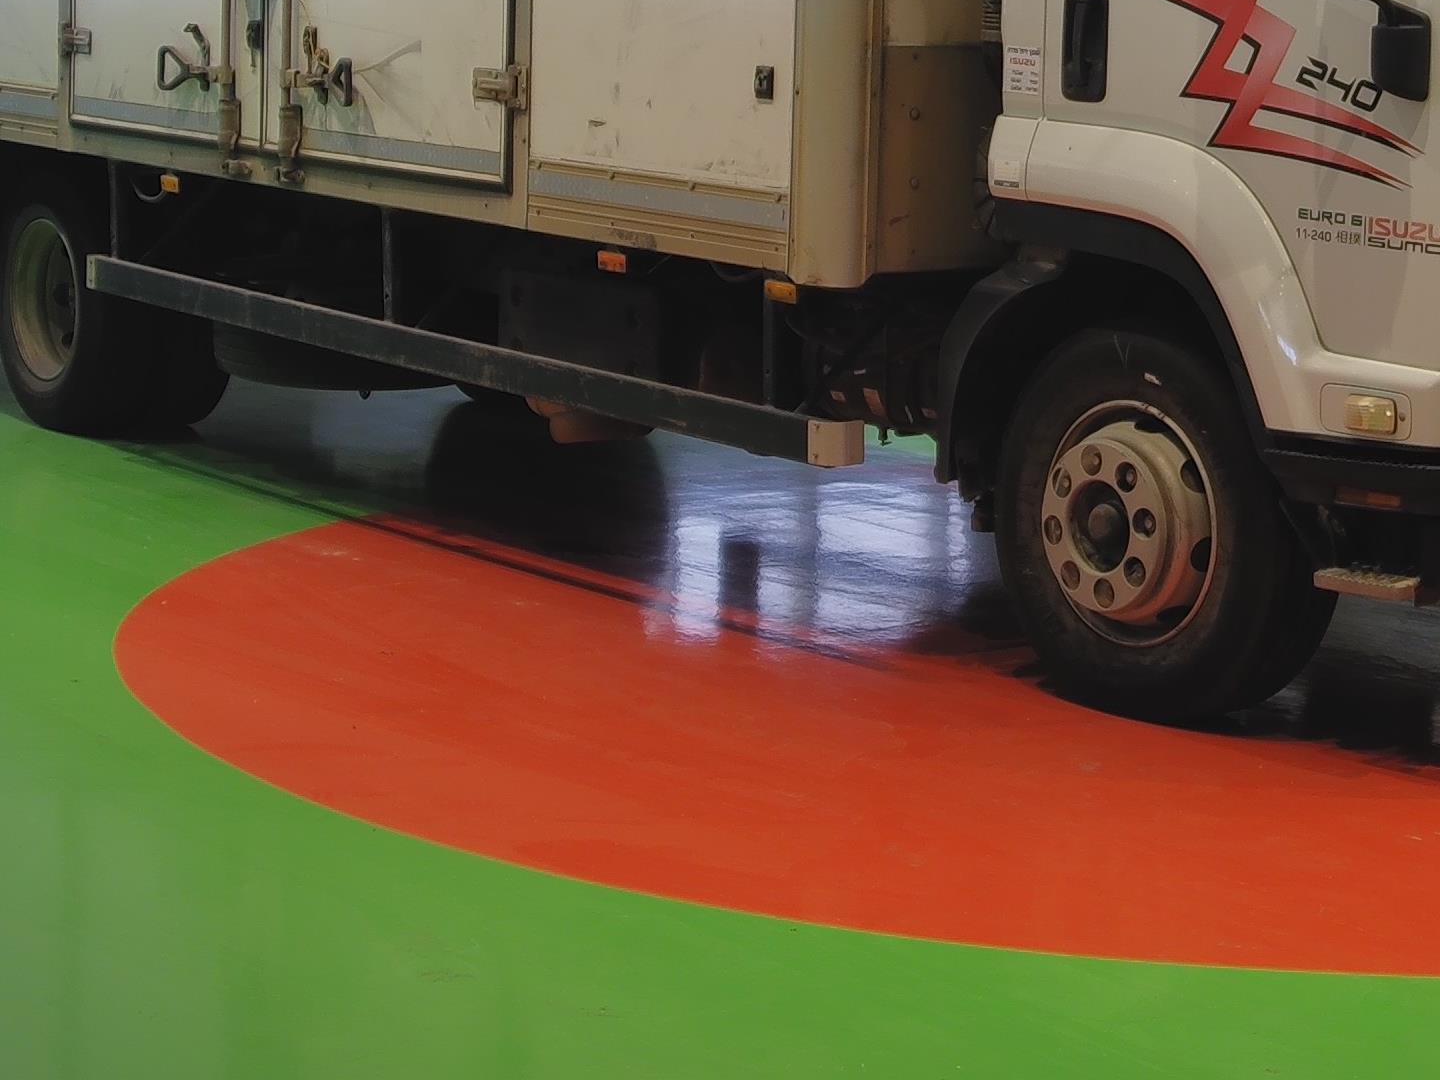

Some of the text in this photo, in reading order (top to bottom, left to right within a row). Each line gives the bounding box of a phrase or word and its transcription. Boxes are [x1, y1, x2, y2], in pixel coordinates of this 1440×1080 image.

[1009, 57, 1036, 67] ISUZU
[1295, 56, 1383, 112] 240
[1297, 207, 1363, 227] EURO 6
